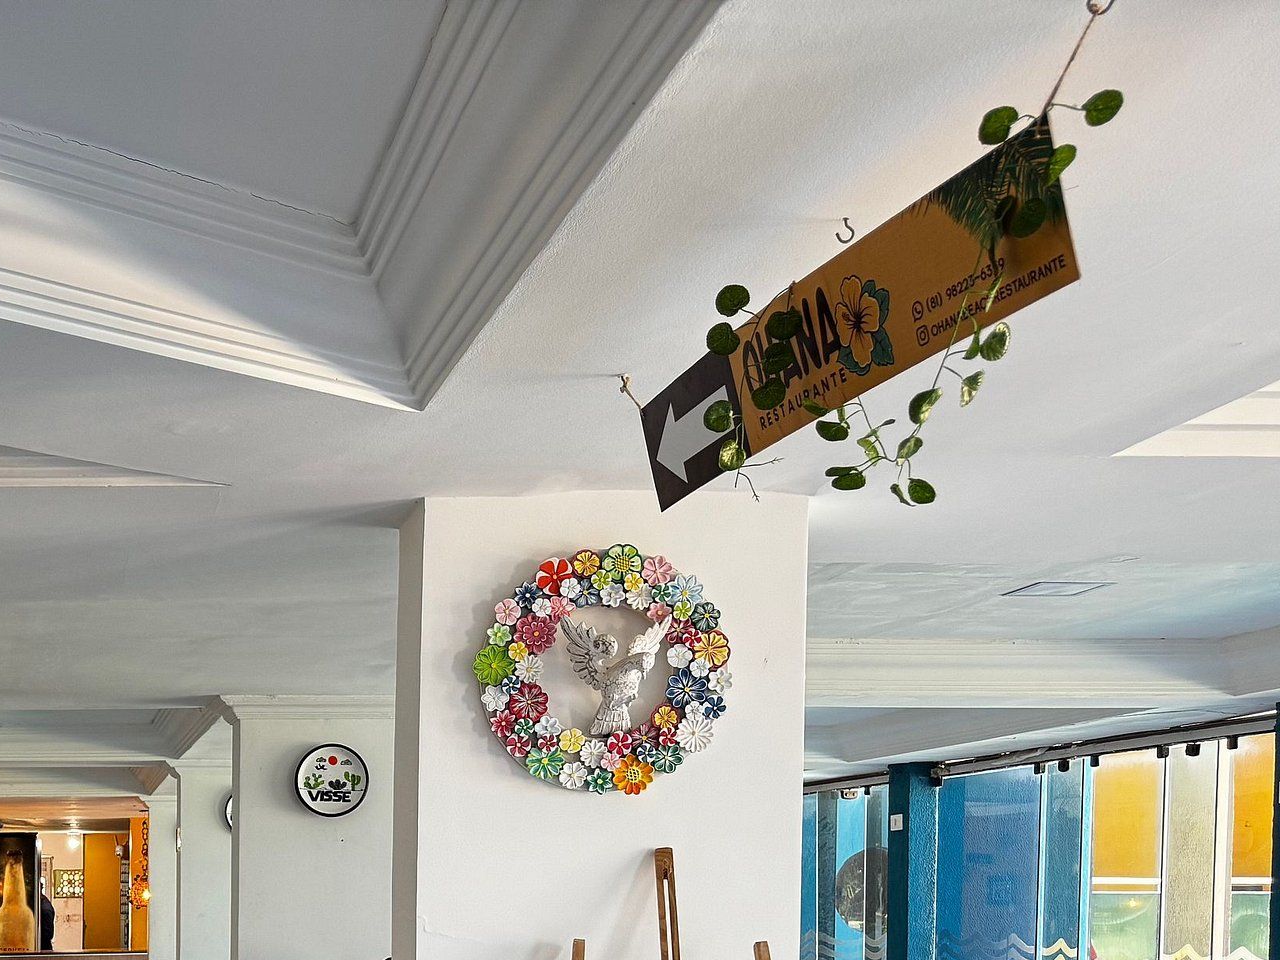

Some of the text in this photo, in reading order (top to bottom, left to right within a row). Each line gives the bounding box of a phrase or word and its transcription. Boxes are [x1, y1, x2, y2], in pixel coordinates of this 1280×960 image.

[926, 258, 1005, 312] (81) 98223-639
[308, 790, 352, 803] VISSE
